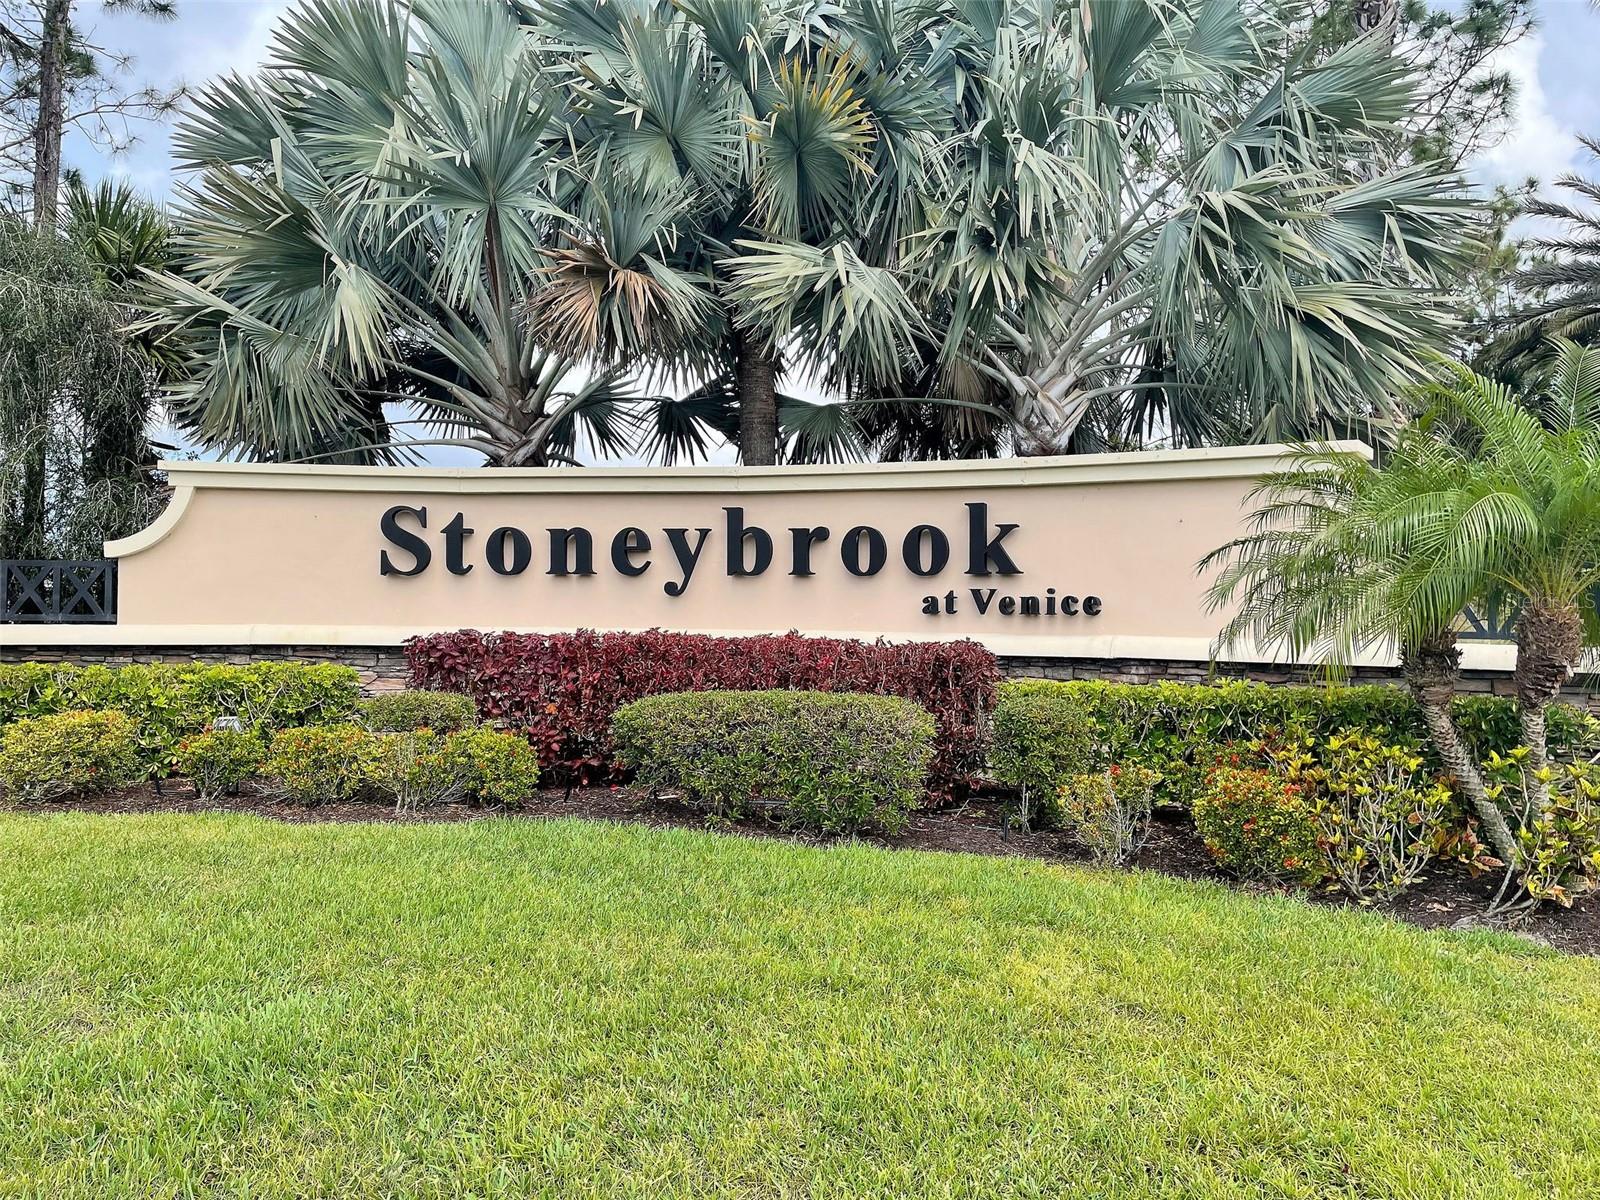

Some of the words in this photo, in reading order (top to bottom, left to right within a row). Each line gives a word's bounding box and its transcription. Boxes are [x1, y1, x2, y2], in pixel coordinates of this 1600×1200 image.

[380, 503, 1023, 597] Stoneybrook
[922, 590, 958, 616] at
[970, 588, 1103, 617] Venice
